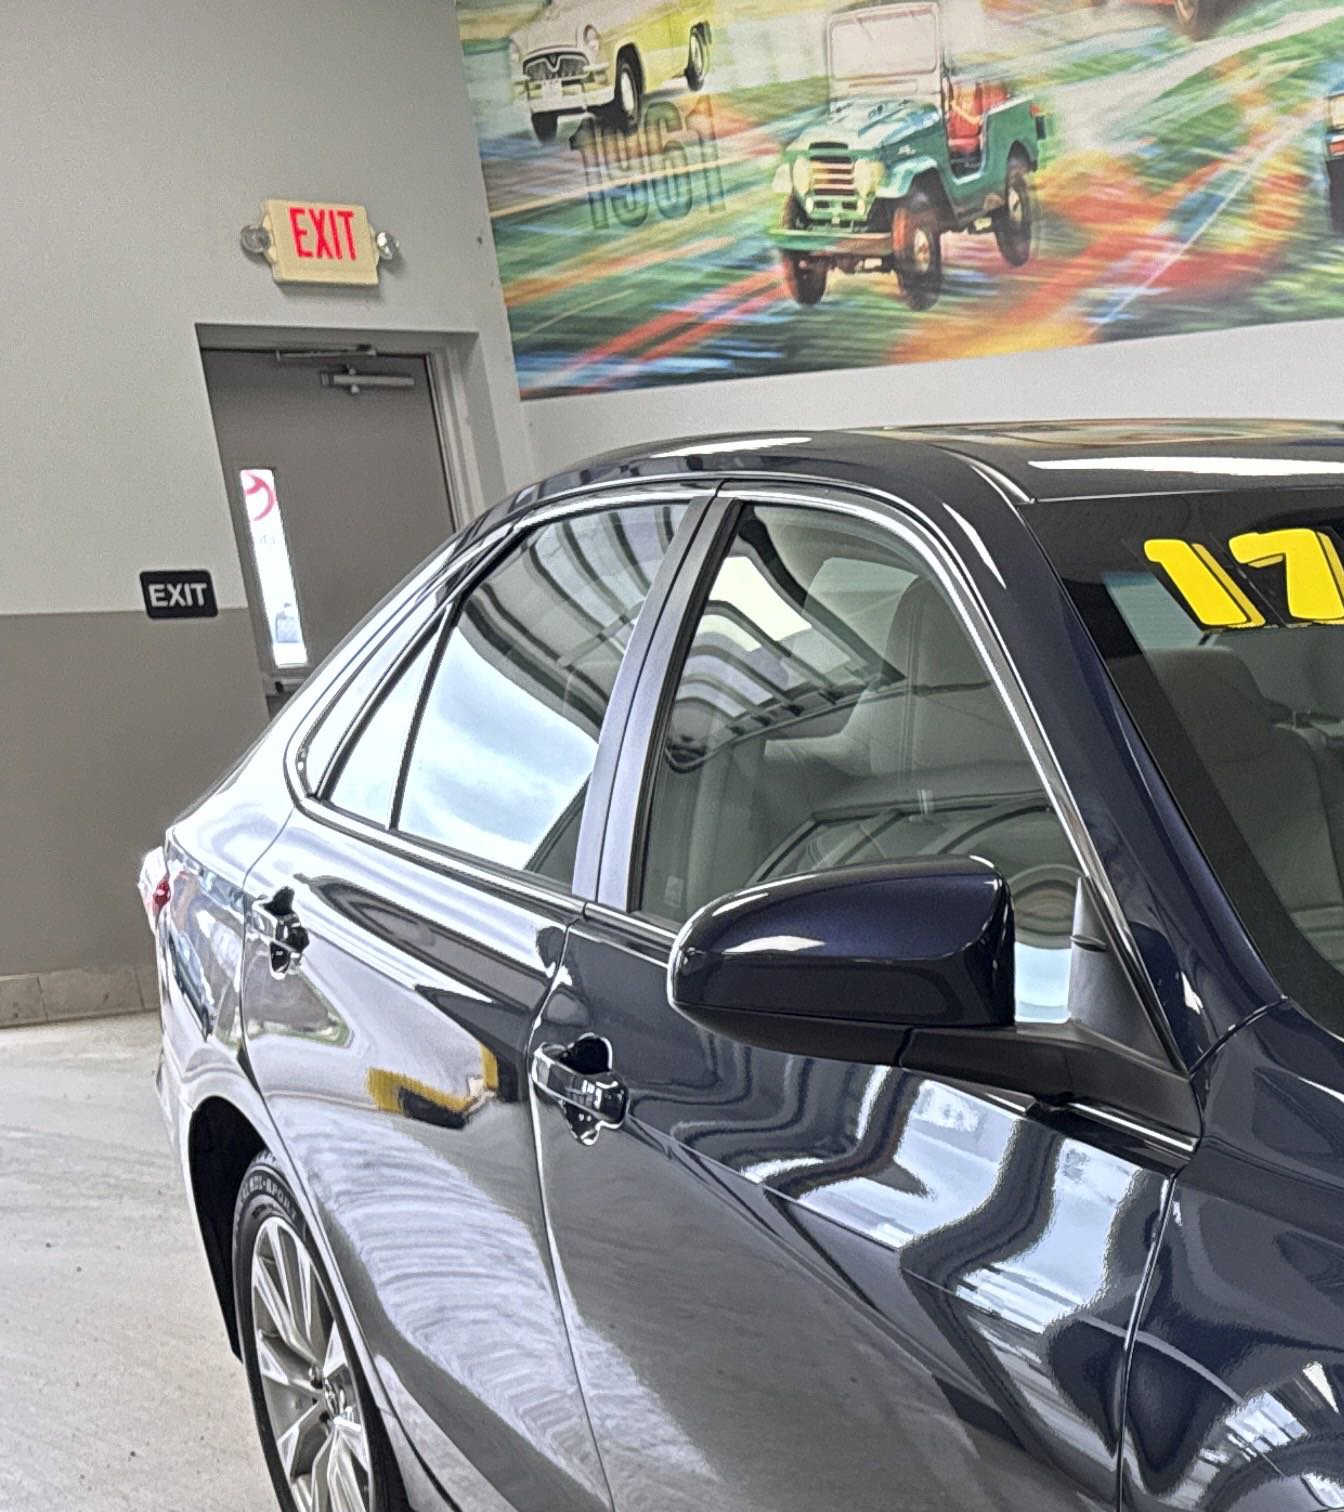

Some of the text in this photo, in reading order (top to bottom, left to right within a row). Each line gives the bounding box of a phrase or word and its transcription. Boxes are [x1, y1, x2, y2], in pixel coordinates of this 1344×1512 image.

[570, 97, 726, 231] 1961
[289, 206, 359, 261] EXIT
[148, 583, 206, 609] EXIT
